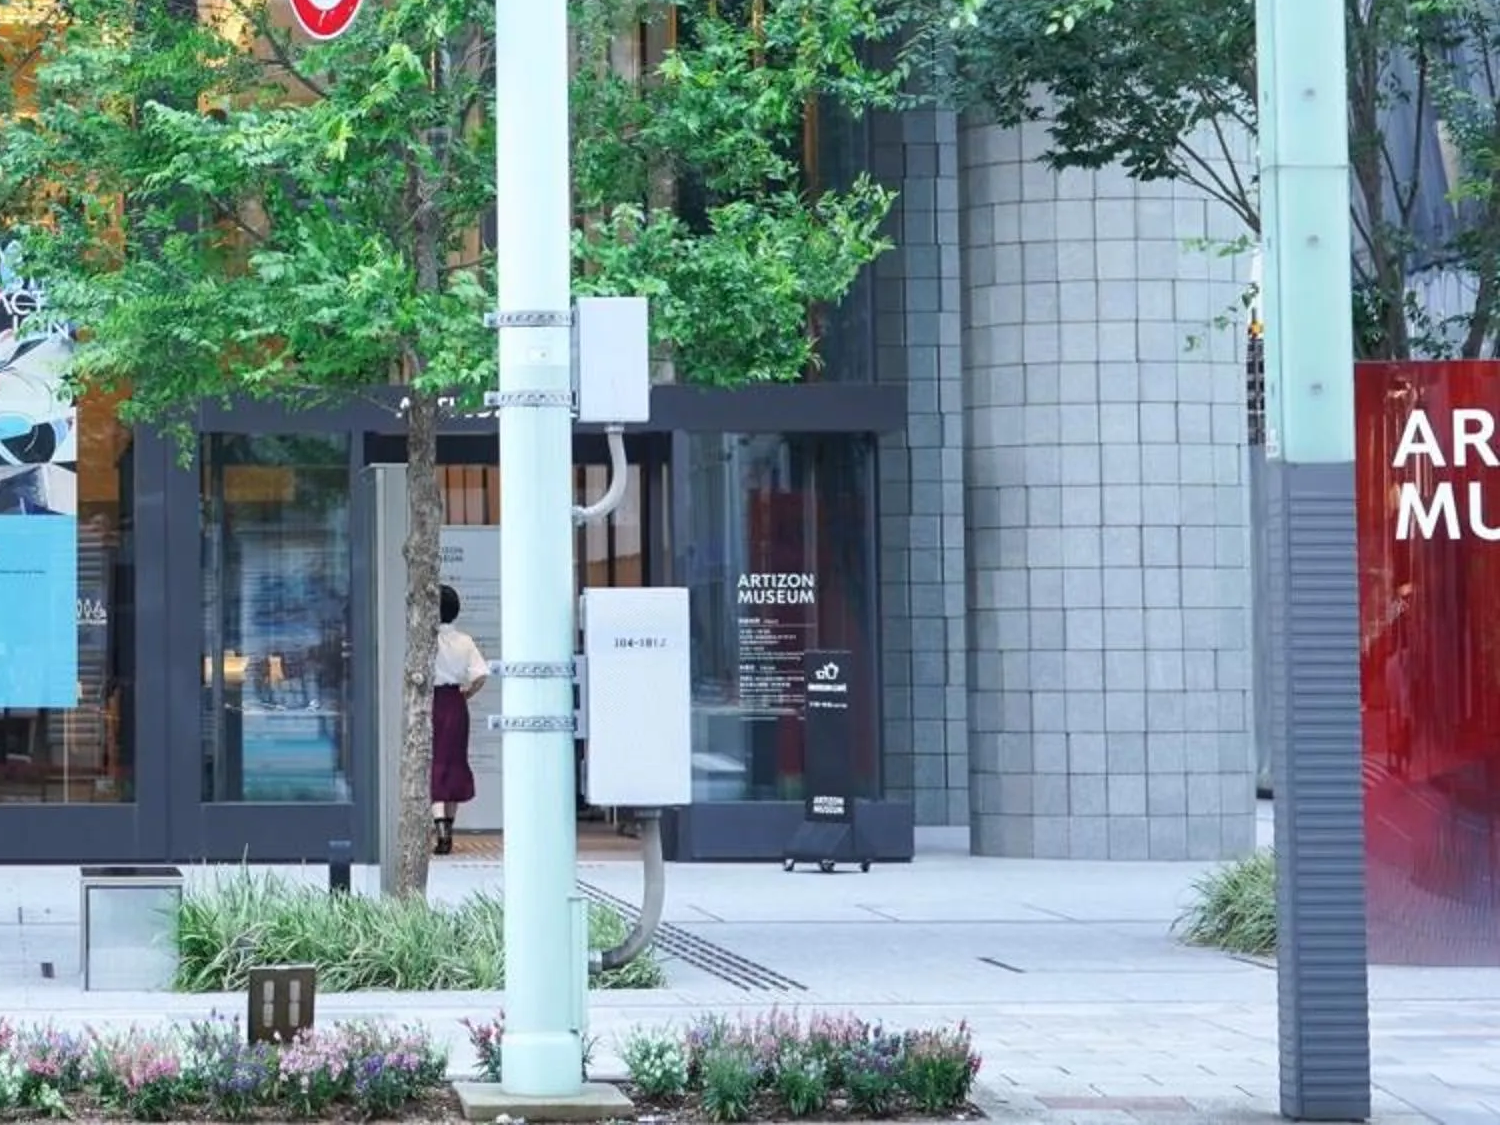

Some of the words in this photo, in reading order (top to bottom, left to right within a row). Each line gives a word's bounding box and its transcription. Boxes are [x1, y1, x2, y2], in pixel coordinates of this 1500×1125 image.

[1392, 409, 1500, 467] AR
[737, 574, 815, 588] ARTIZON
[737, 589, 815, 604] MUSEUM
